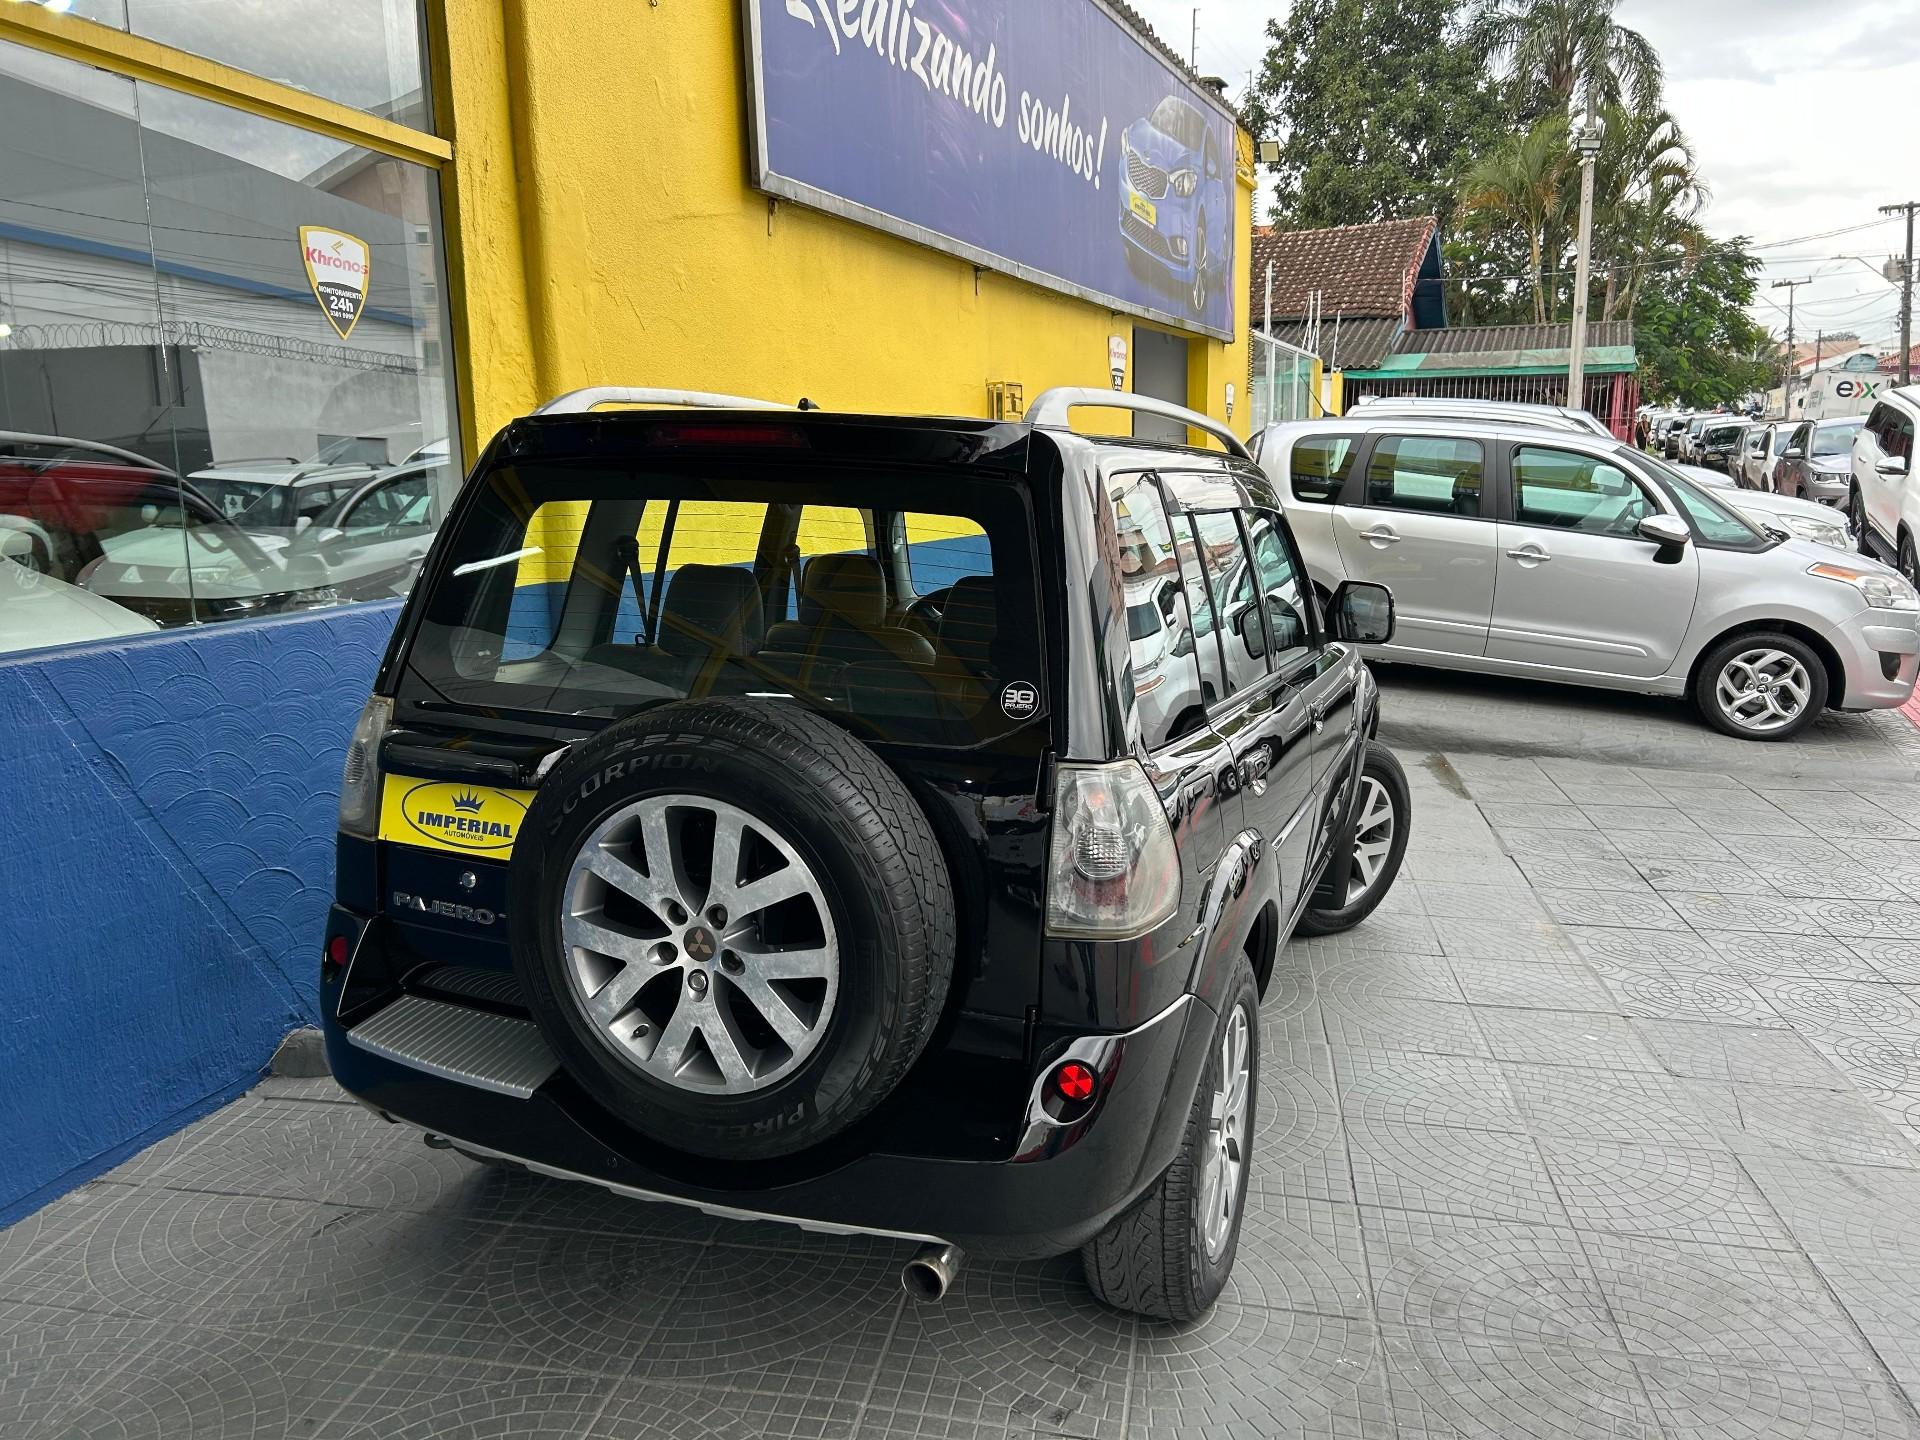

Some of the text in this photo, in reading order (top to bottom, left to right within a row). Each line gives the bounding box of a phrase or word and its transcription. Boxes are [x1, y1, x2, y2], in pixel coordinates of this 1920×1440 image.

[1018, 91, 1107, 190] sonhos!
[305, 246, 369, 275] Khronos
[318, 285, 363, 300] MONITORAMENTO
[330, 295, 354, 313] 24h
[1005, 689, 1034, 704] 30
[546, 752, 714, 837] SCORPION
[417, 811, 513, 839] IMPERIAL
[443, 829, 485, 842] AUTOMÓVEIS
[393, 890, 497, 926] PAJERO
[682, 1101, 805, 1141] PIRELL
